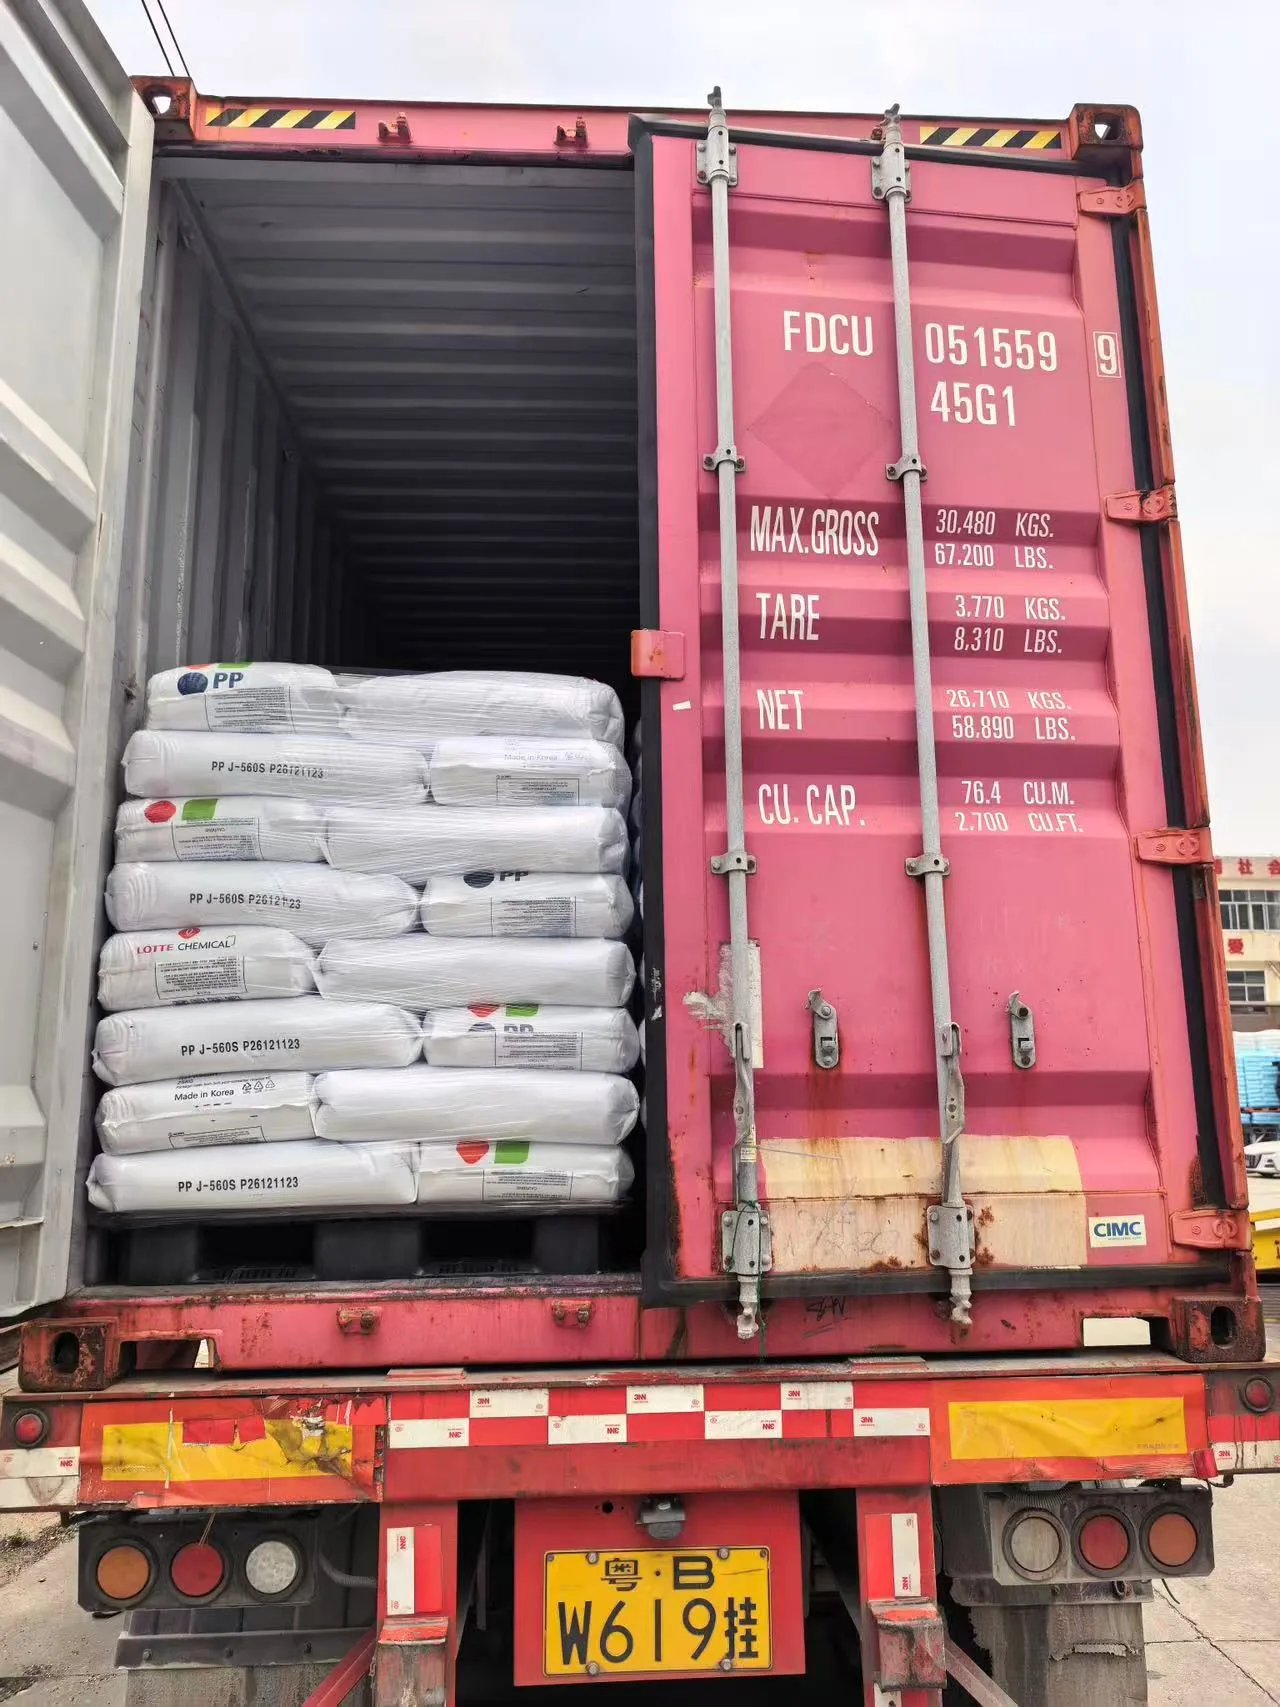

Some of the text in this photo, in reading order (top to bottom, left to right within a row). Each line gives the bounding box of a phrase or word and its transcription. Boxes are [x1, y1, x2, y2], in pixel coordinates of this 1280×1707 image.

[783, 310, 1118, 376] FDCU 051559 9
[930, 380, 1016, 427] 45G1
[750, 505, 879, 556] MAX.GROSS
[1015, 512, 1054, 538] KGS.
[1014, 545, 1054, 569] LBS.
[755, 593, 820, 641] TARE
[1024, 597, 1066, 620] KGS.
[1023, 629, 1063, 654] LBS.
[213, 672, 244, 689] PP
[756, 689, 804, 732] NET
[1027, 691, 1071, 710] KGS.
[1034, 717, 1076, 741] LBS.
[211, 761, 225, 771] PP
[228, 762, 266, 773] J-560S
[758, 780, 1075, 826] CU. CAP. 76.4 CU.M.
[1027, 812, 1084, 833] CU.FT.
[189, 893, 203, 904] PP
[206, 893, 245, 904] J-560S
[137, 940, 230, 955] LOTTE CHEMICAL
[181, 1038, 300, 1056] PP J-560S P26121123
[174, 1092, 199, 1101] Made
[200, 1089, 208, 1099] in
[210, 1088, 235, 1098] Korea
[178, 1176, 299, 1192] PP J-560S P26121123
[1093, 1222, 1142, 1237] CIMC
